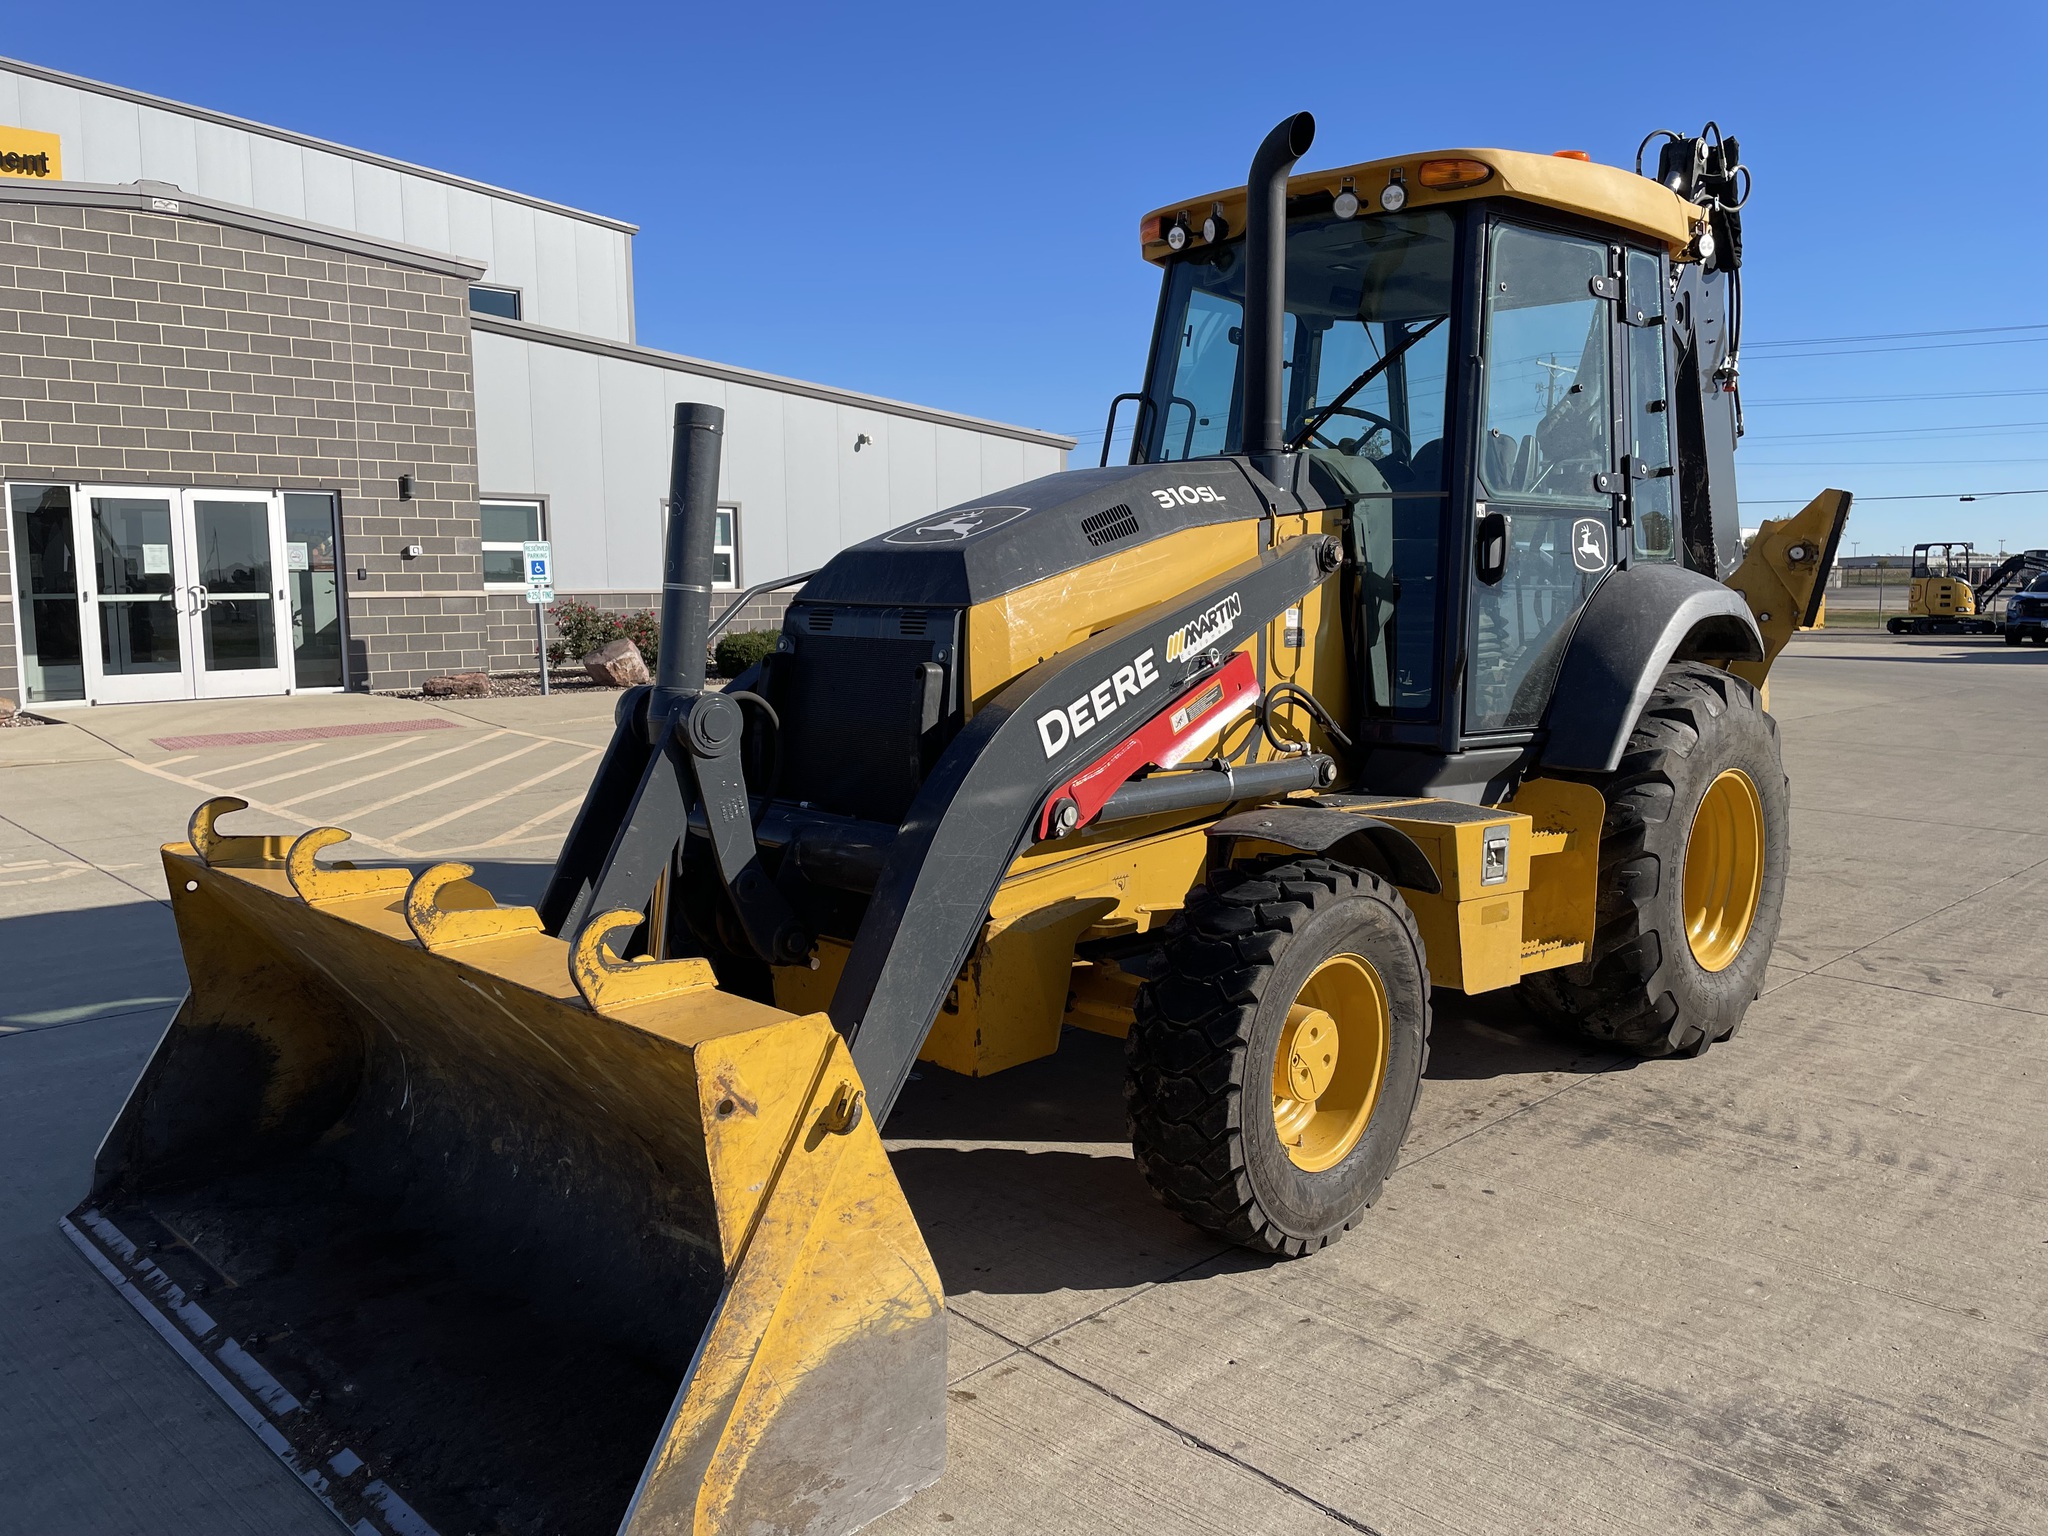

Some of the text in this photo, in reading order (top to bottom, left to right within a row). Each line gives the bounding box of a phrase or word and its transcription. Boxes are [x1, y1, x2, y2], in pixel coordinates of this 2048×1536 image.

[1151, 485, 1226, 509] 310SL
[542, 590, 553, 599] FINE
[1183, 592, 1241, 650] MARTIN
[1036, 647, 1160, 759] DEERE
